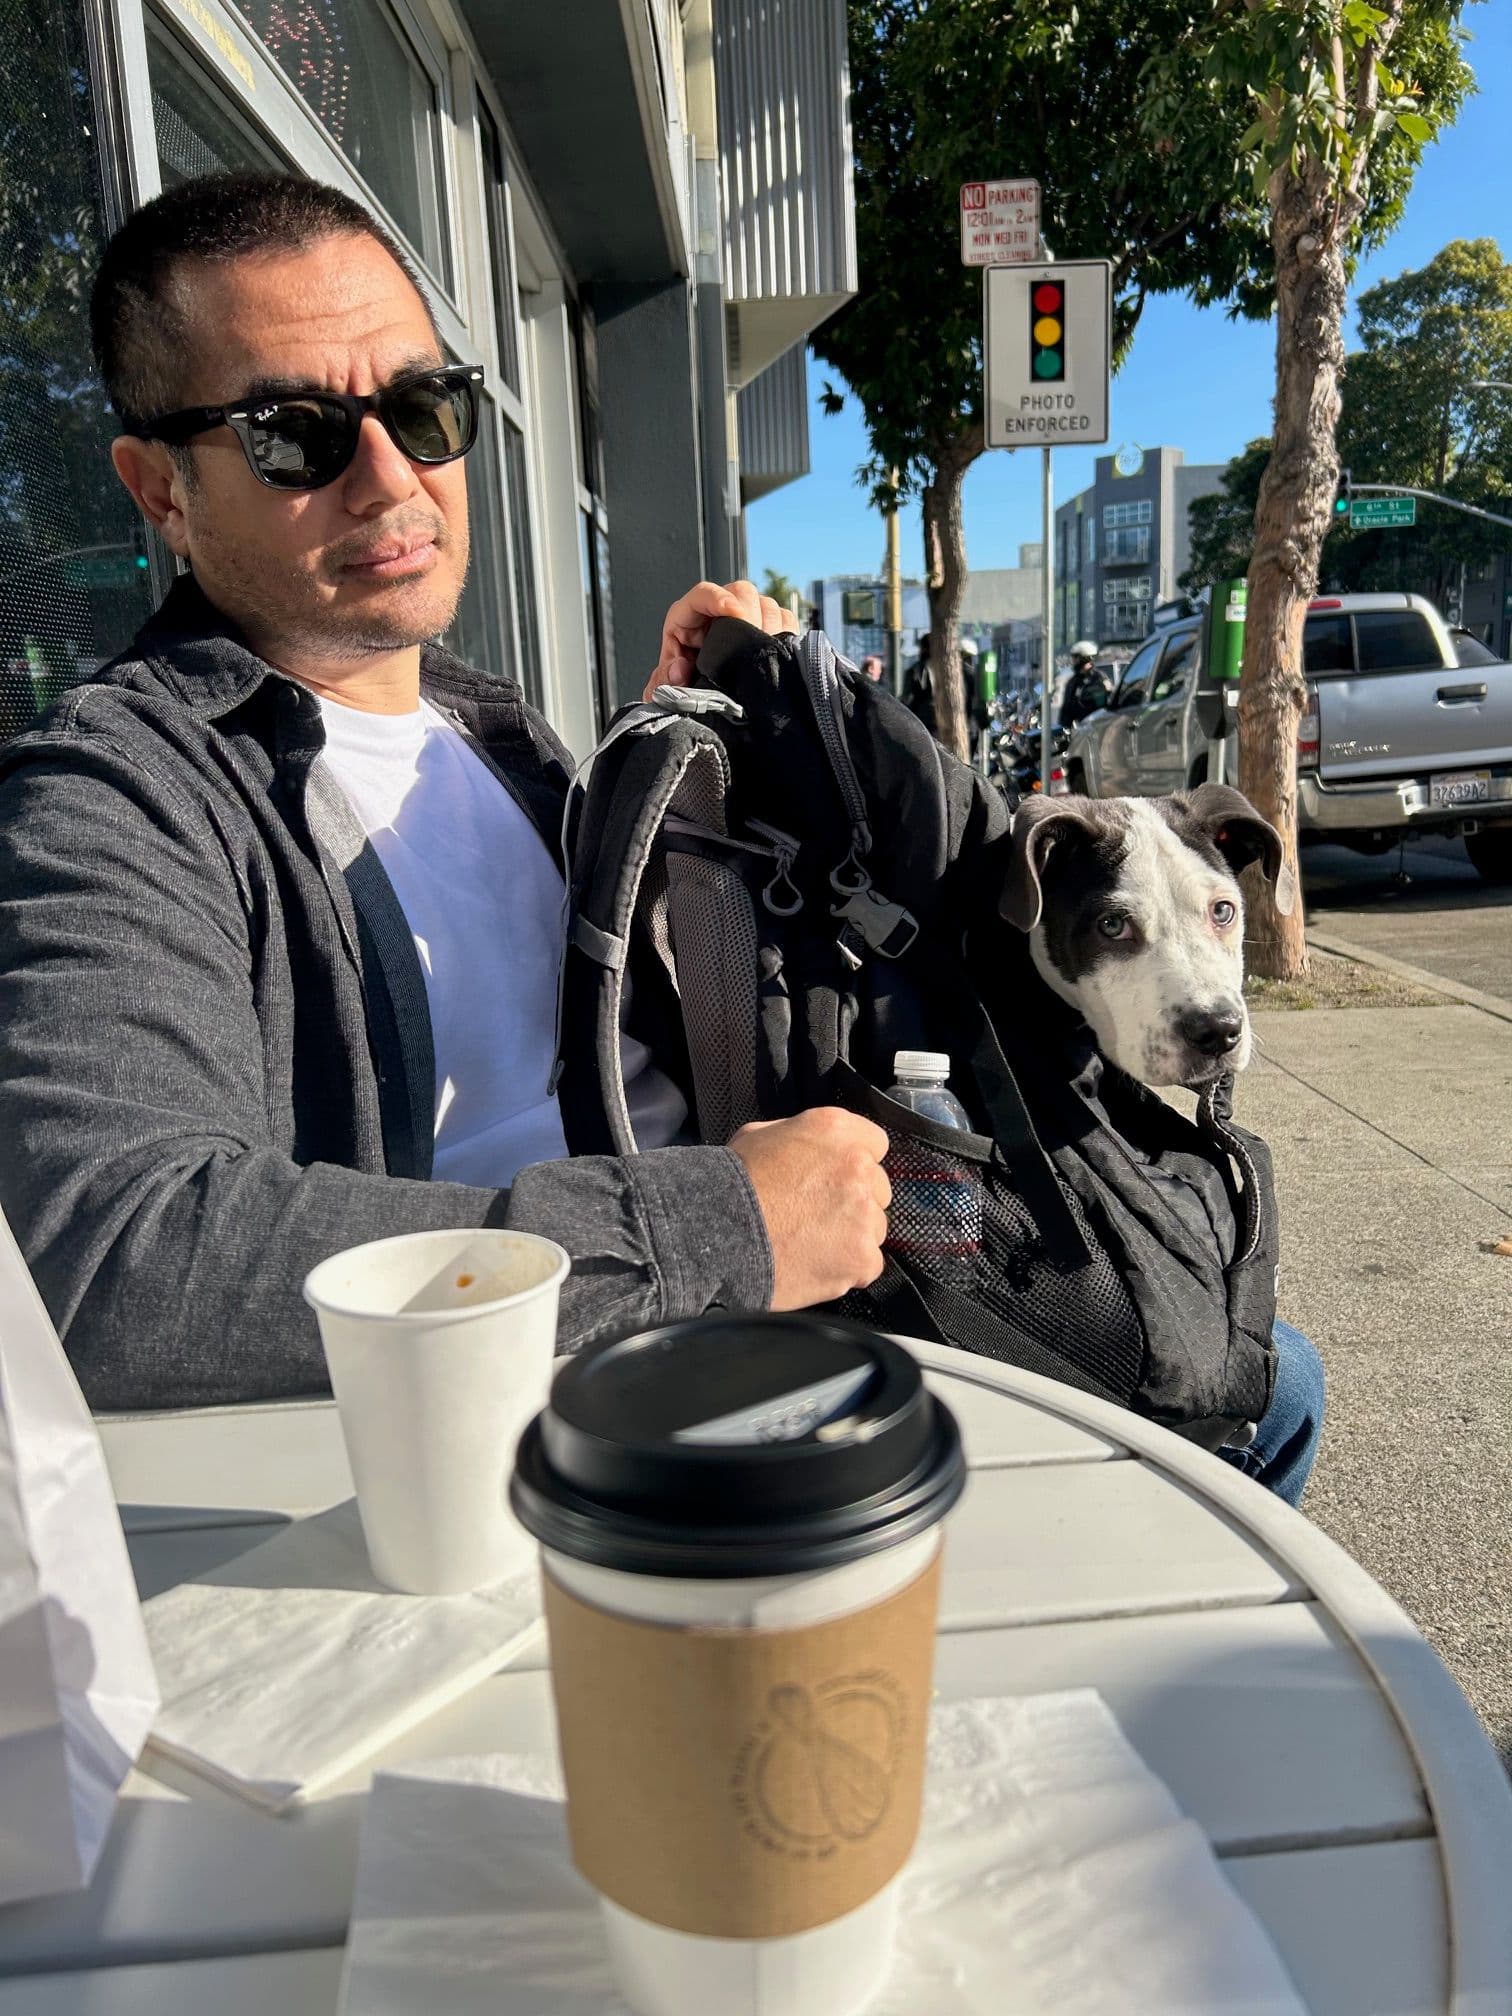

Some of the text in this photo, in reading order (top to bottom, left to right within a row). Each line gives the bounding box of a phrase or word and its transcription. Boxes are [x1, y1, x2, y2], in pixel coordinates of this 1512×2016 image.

[964, 186, 1034, 208] NO PARKING
[973, 230, 1027, 246] MON WED FRI
[1020, 394, 1075, 410] PHOTO
[1005, 415, 1090, 433] ENFORCED
